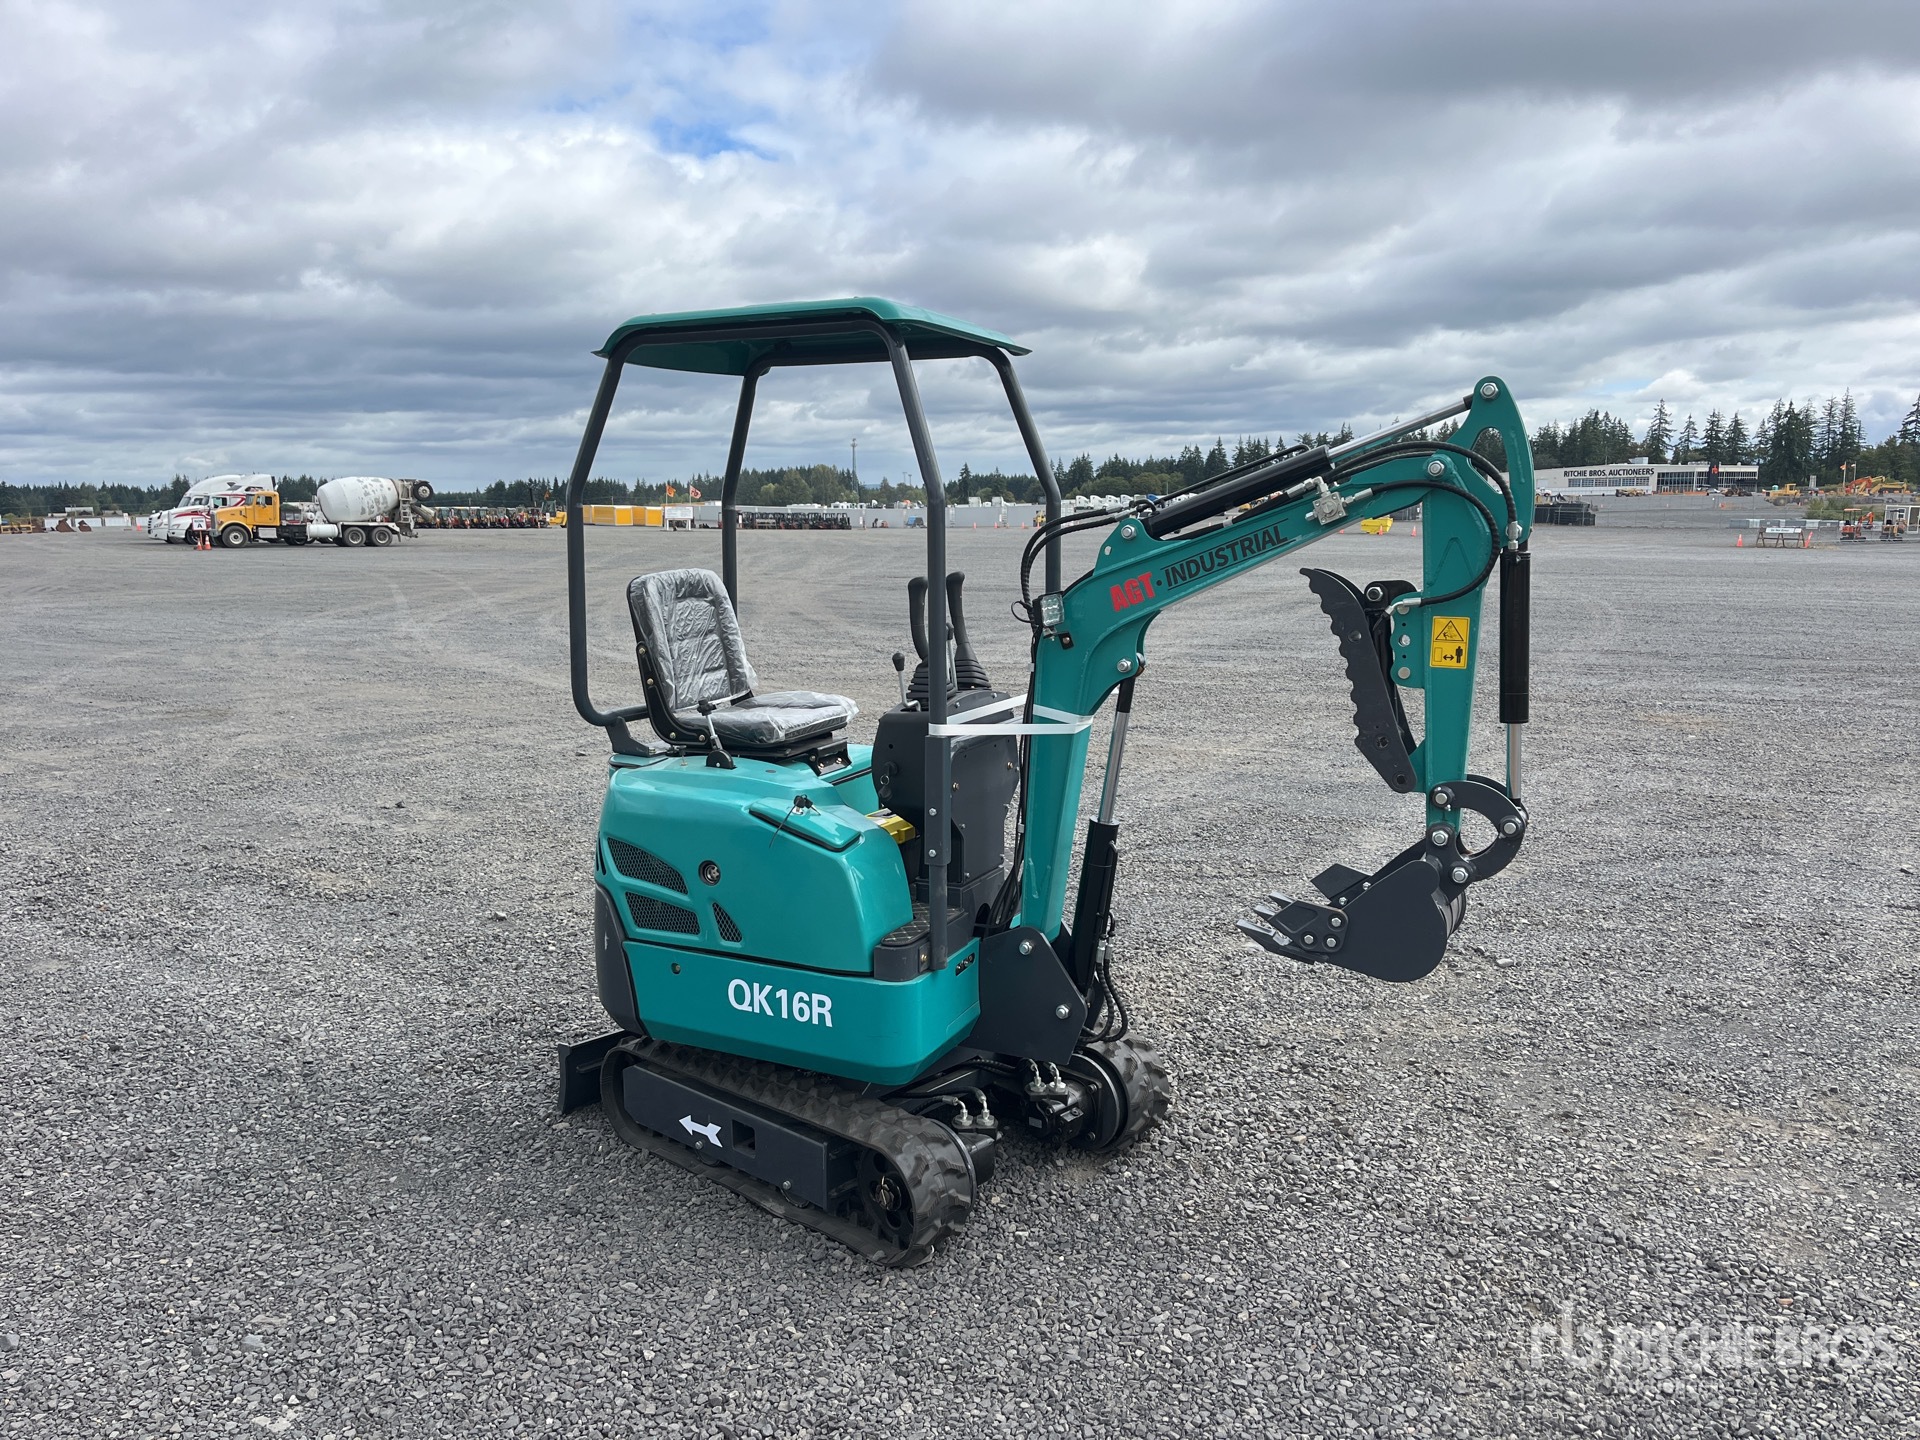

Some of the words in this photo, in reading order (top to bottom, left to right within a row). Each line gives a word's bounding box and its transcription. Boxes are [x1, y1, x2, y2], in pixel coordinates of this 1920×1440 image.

[1588, 469, 1607, 477] BROS.
[1608, 468, 1655, 476] AUCTIONEERS
[1109, 571, 1156, 612] AGT
[1165, 525, 1288, 587] INDUSTRIAL
[728, 978, 833, 1028] QK16R
